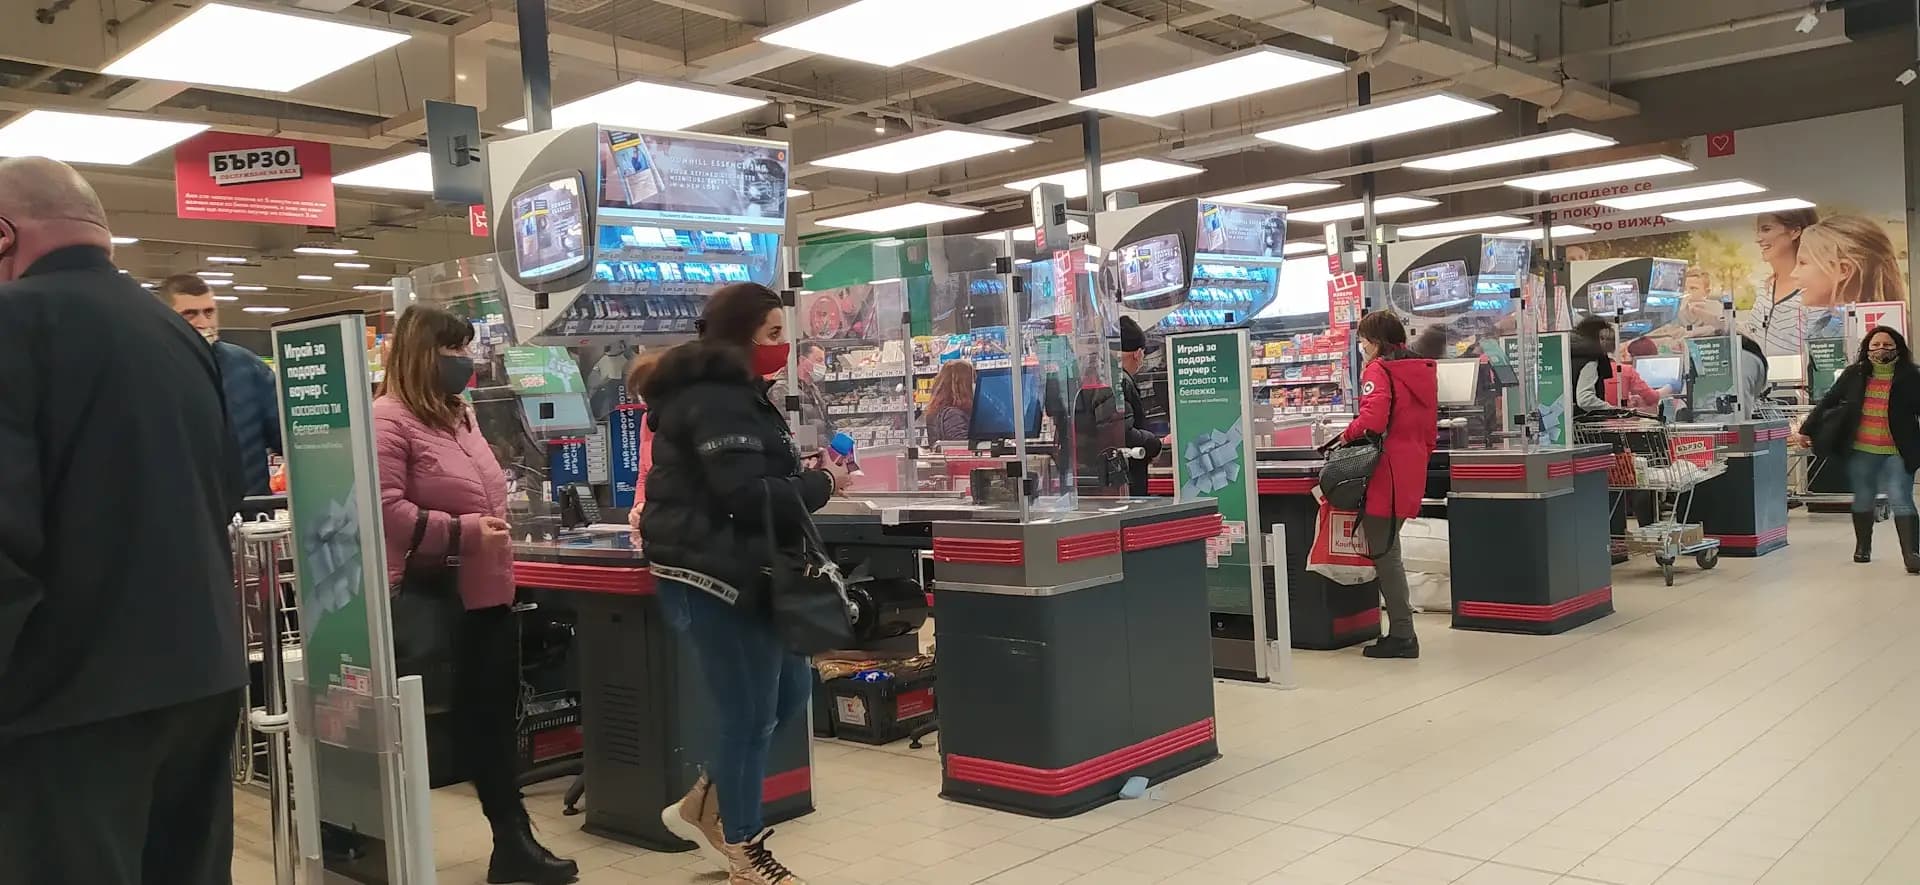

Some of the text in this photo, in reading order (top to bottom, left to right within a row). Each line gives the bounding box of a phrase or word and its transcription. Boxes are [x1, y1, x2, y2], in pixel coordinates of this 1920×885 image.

[214, 149, 291, 172] БЪРЗО
[1551, 181, 1652, 204] асладете се
[284, 342, 326, 361] Играй за
[1177, 343, 1217, 355] Играй за
[1178, 355, 1217, 365] подарък
[287, 364, 327, 380] подарък
[1178, 367, 1210, 376] ваучер
[1179, 376, 1229, 386] касовата ти
[289, 384, 329, 400] ваучер с
[1180, 386, 1216, 397] бележка
[291, 403, 342, 417] касовата ти
[292, 421, 330, 436] бележка
[628, 415, 635, 429] ОТ
